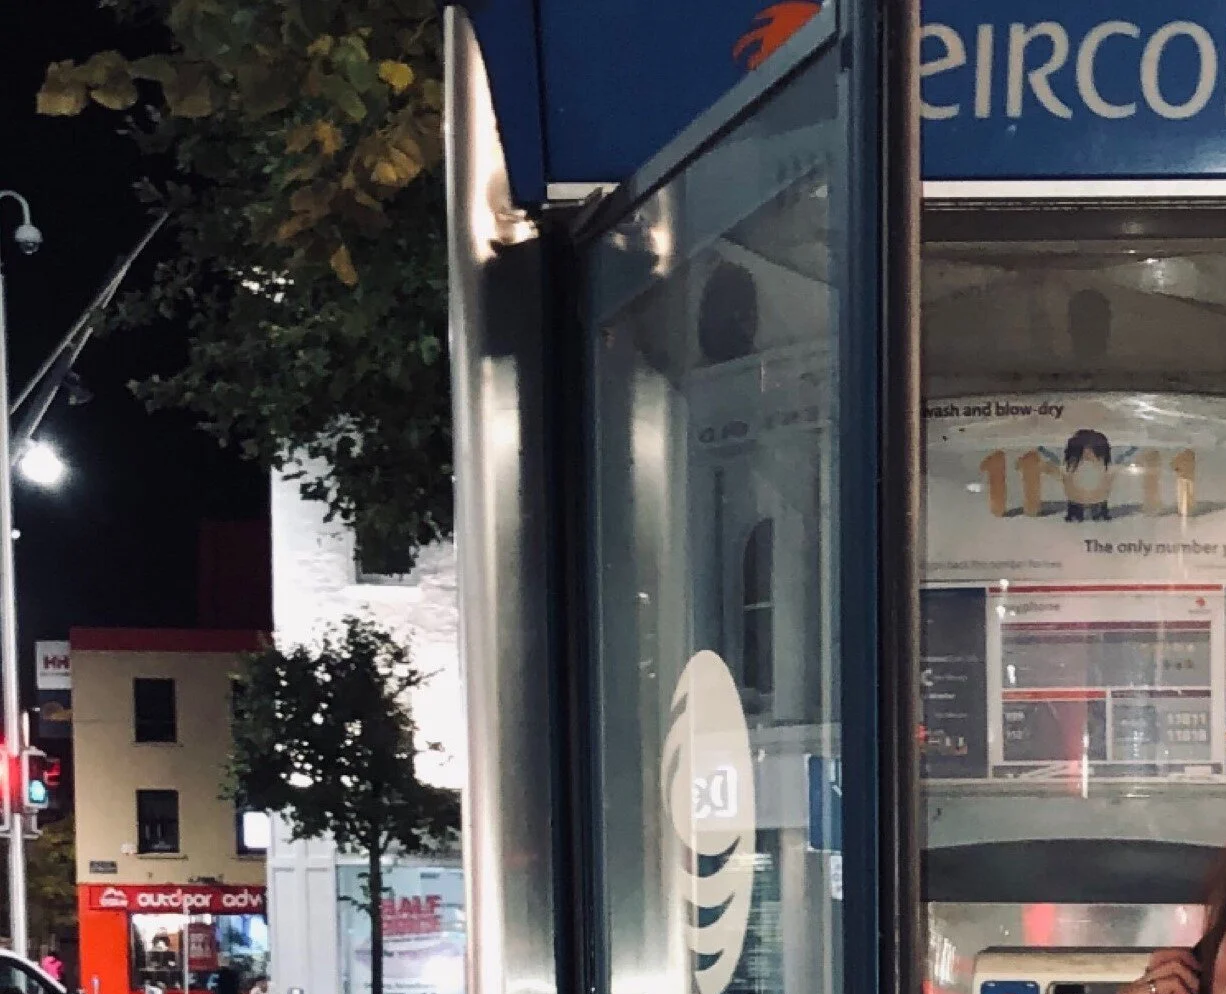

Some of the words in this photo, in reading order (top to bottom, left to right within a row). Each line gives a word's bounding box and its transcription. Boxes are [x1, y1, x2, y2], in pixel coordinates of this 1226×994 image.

[963, 401, 992, 417] and
[995, 401, 1065, 419] blow-dry
[1084, 539, 1113, 554] The
[1117, 539, 1151, 557] only
[1156, 540, 1218, 554] number
[222, 889, 264, 908] adv
